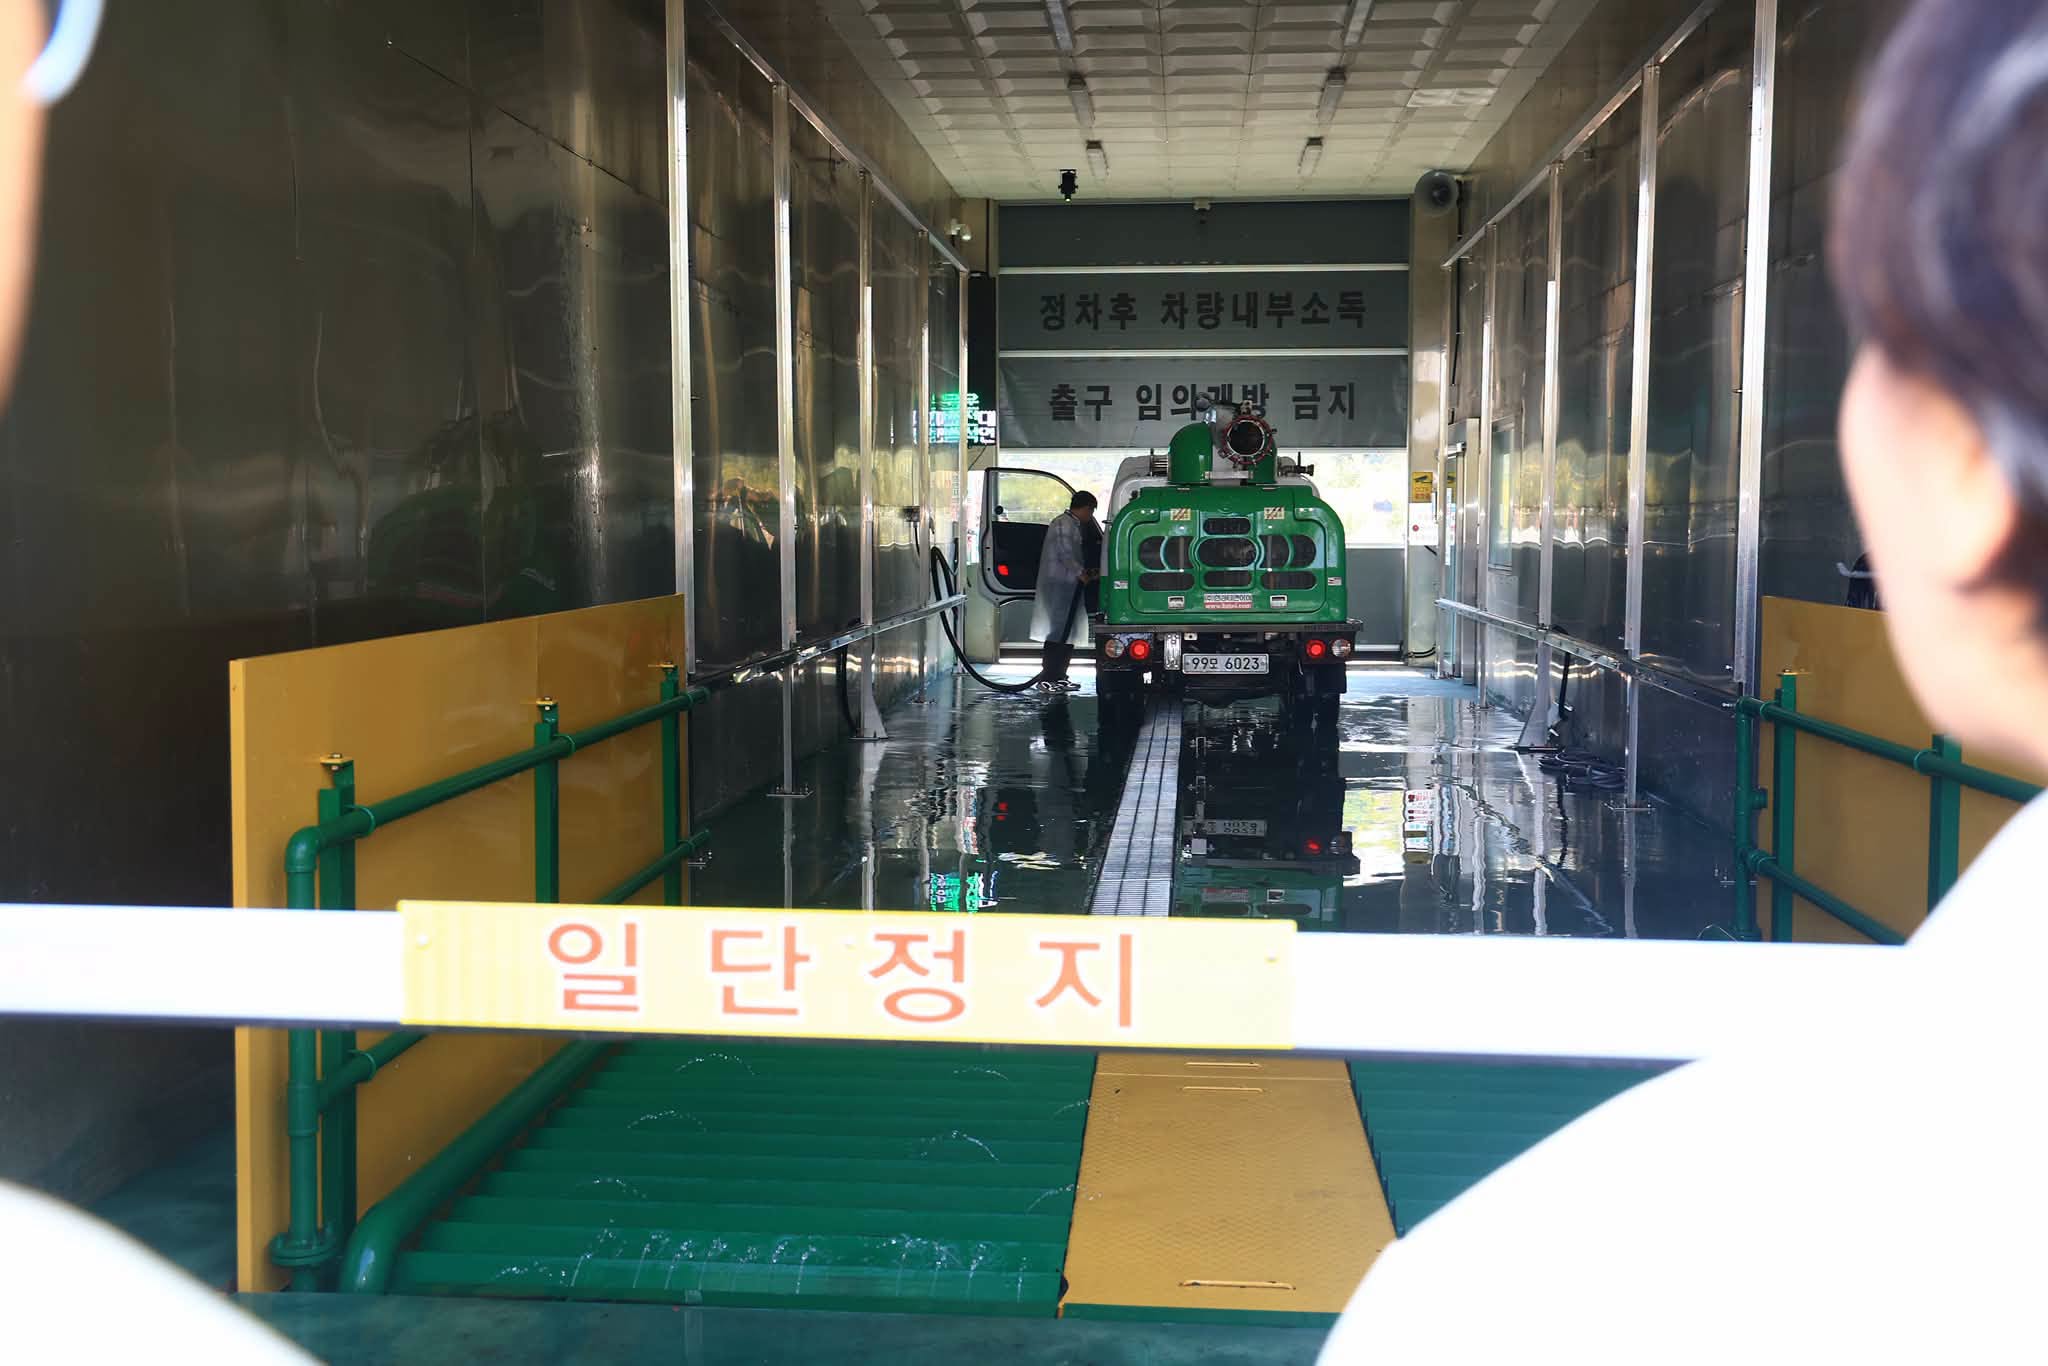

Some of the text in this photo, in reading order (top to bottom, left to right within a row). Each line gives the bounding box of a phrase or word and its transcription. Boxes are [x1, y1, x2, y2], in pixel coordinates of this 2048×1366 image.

[1040, 290, 1367, 331] 정차후 차량내부소독
[1048, 382, 1356, 422] 출구 임의개방 금지
[1192, 657, 1259, 670] 99모 6023
[547, 922, 1133, 1028] 일단정지
